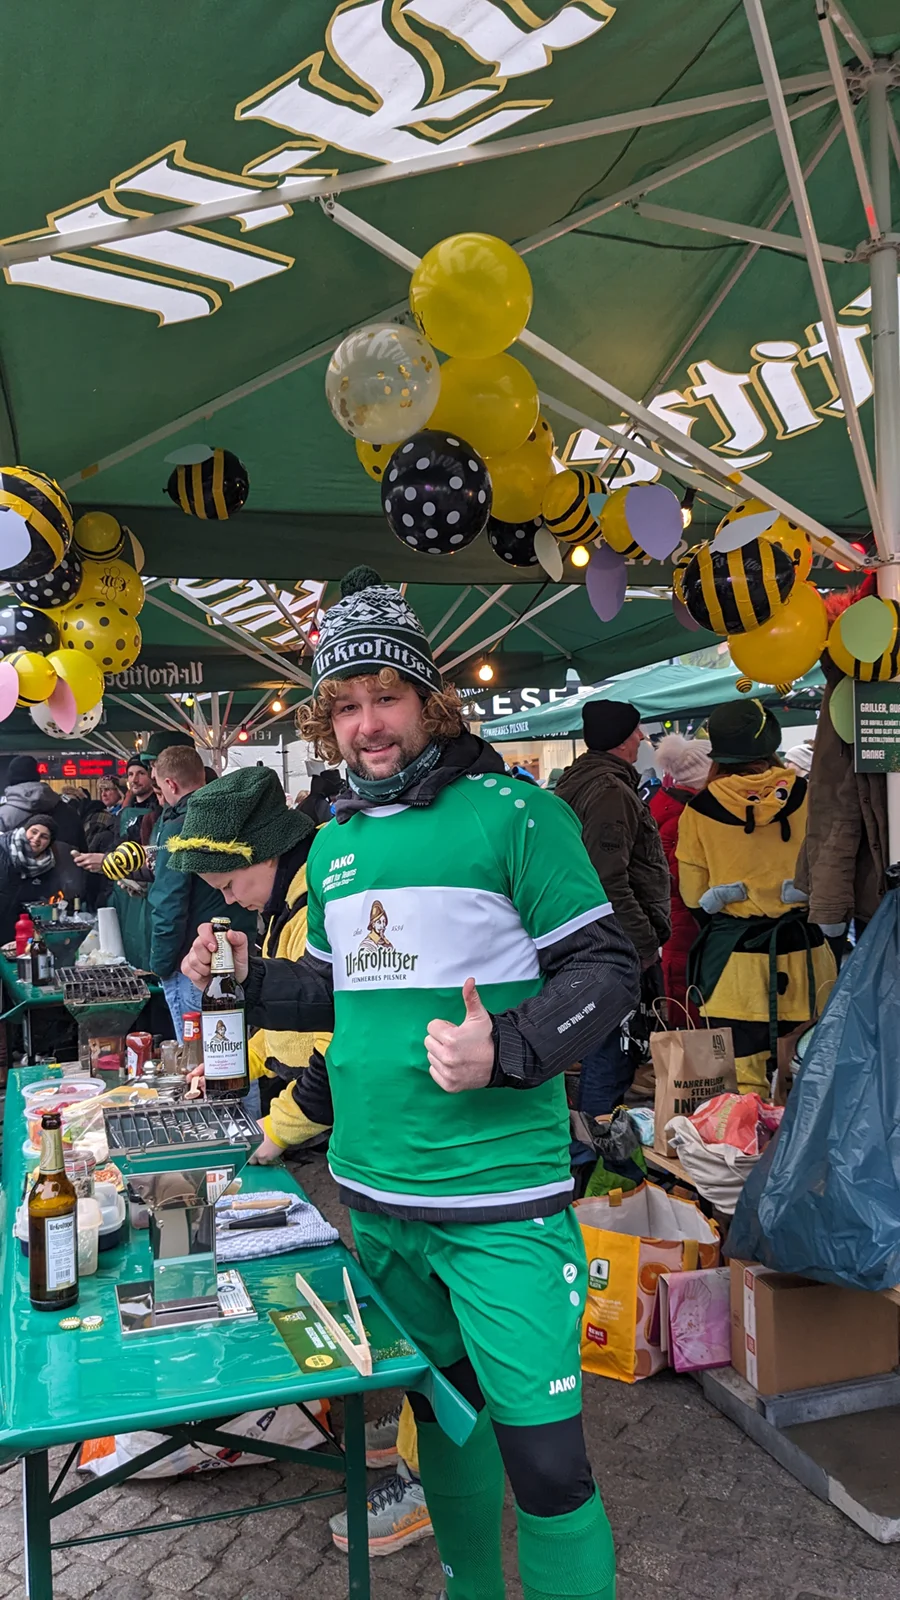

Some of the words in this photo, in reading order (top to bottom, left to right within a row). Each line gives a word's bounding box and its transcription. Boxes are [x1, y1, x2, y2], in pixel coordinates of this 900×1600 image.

[860, 702, 888, 714] GRILLER,
[862, 750, 885, 759] DANKE!
[329, 853, 355, 872] JAKO
[351, 974, 382, 984] FEINHERBES
[712, 1034, 726, 1052] 490
[674, 1080, 704, 1089] WAHRE
[548, 1374, 576, 1394] JAKO
